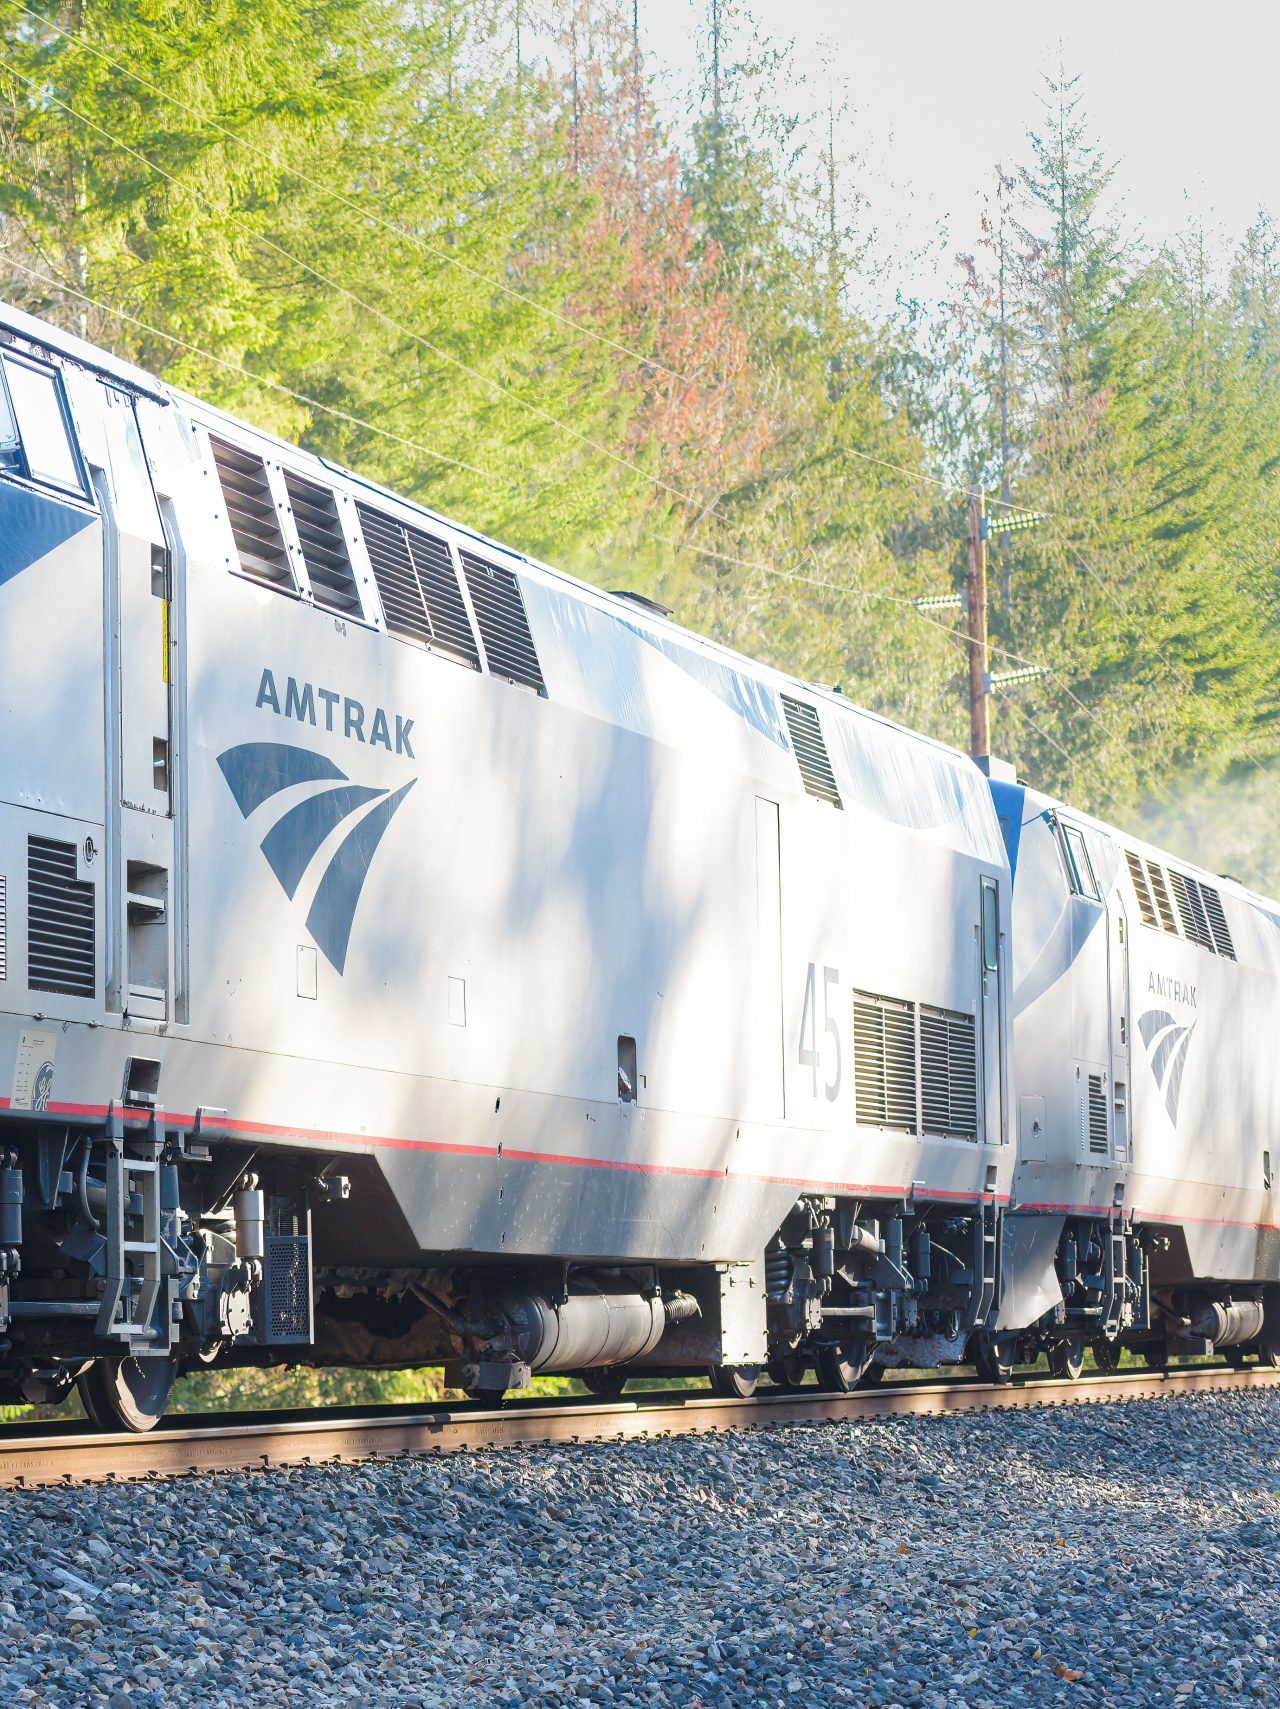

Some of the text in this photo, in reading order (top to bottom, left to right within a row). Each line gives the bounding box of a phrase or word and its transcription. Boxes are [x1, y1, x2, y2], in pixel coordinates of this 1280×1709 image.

[255, 668, 416, 759] AMTRAK
[799, 962, 841, 1102] 45
[1148, 971, 1197, 1008] AMTRAK
